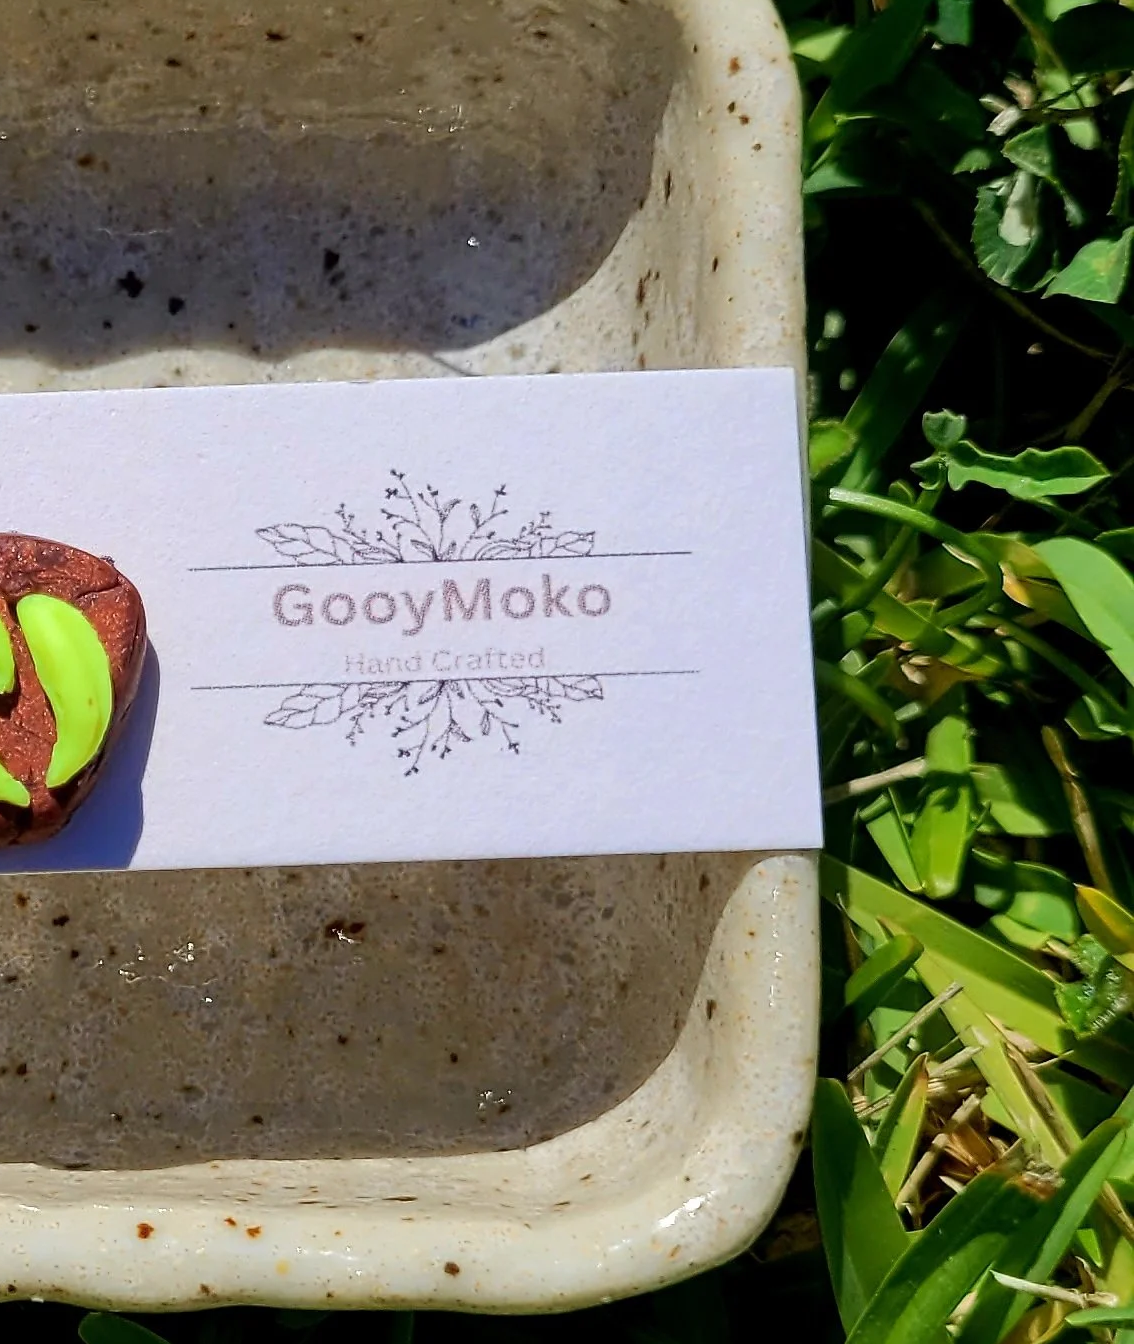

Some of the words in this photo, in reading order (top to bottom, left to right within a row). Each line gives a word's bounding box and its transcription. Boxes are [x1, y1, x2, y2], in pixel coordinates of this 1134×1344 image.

[272, 574, 611, 636] GooyMoko
[344, 651, 422, 674] Hand
[432, 648, 546, 672] Crafted
